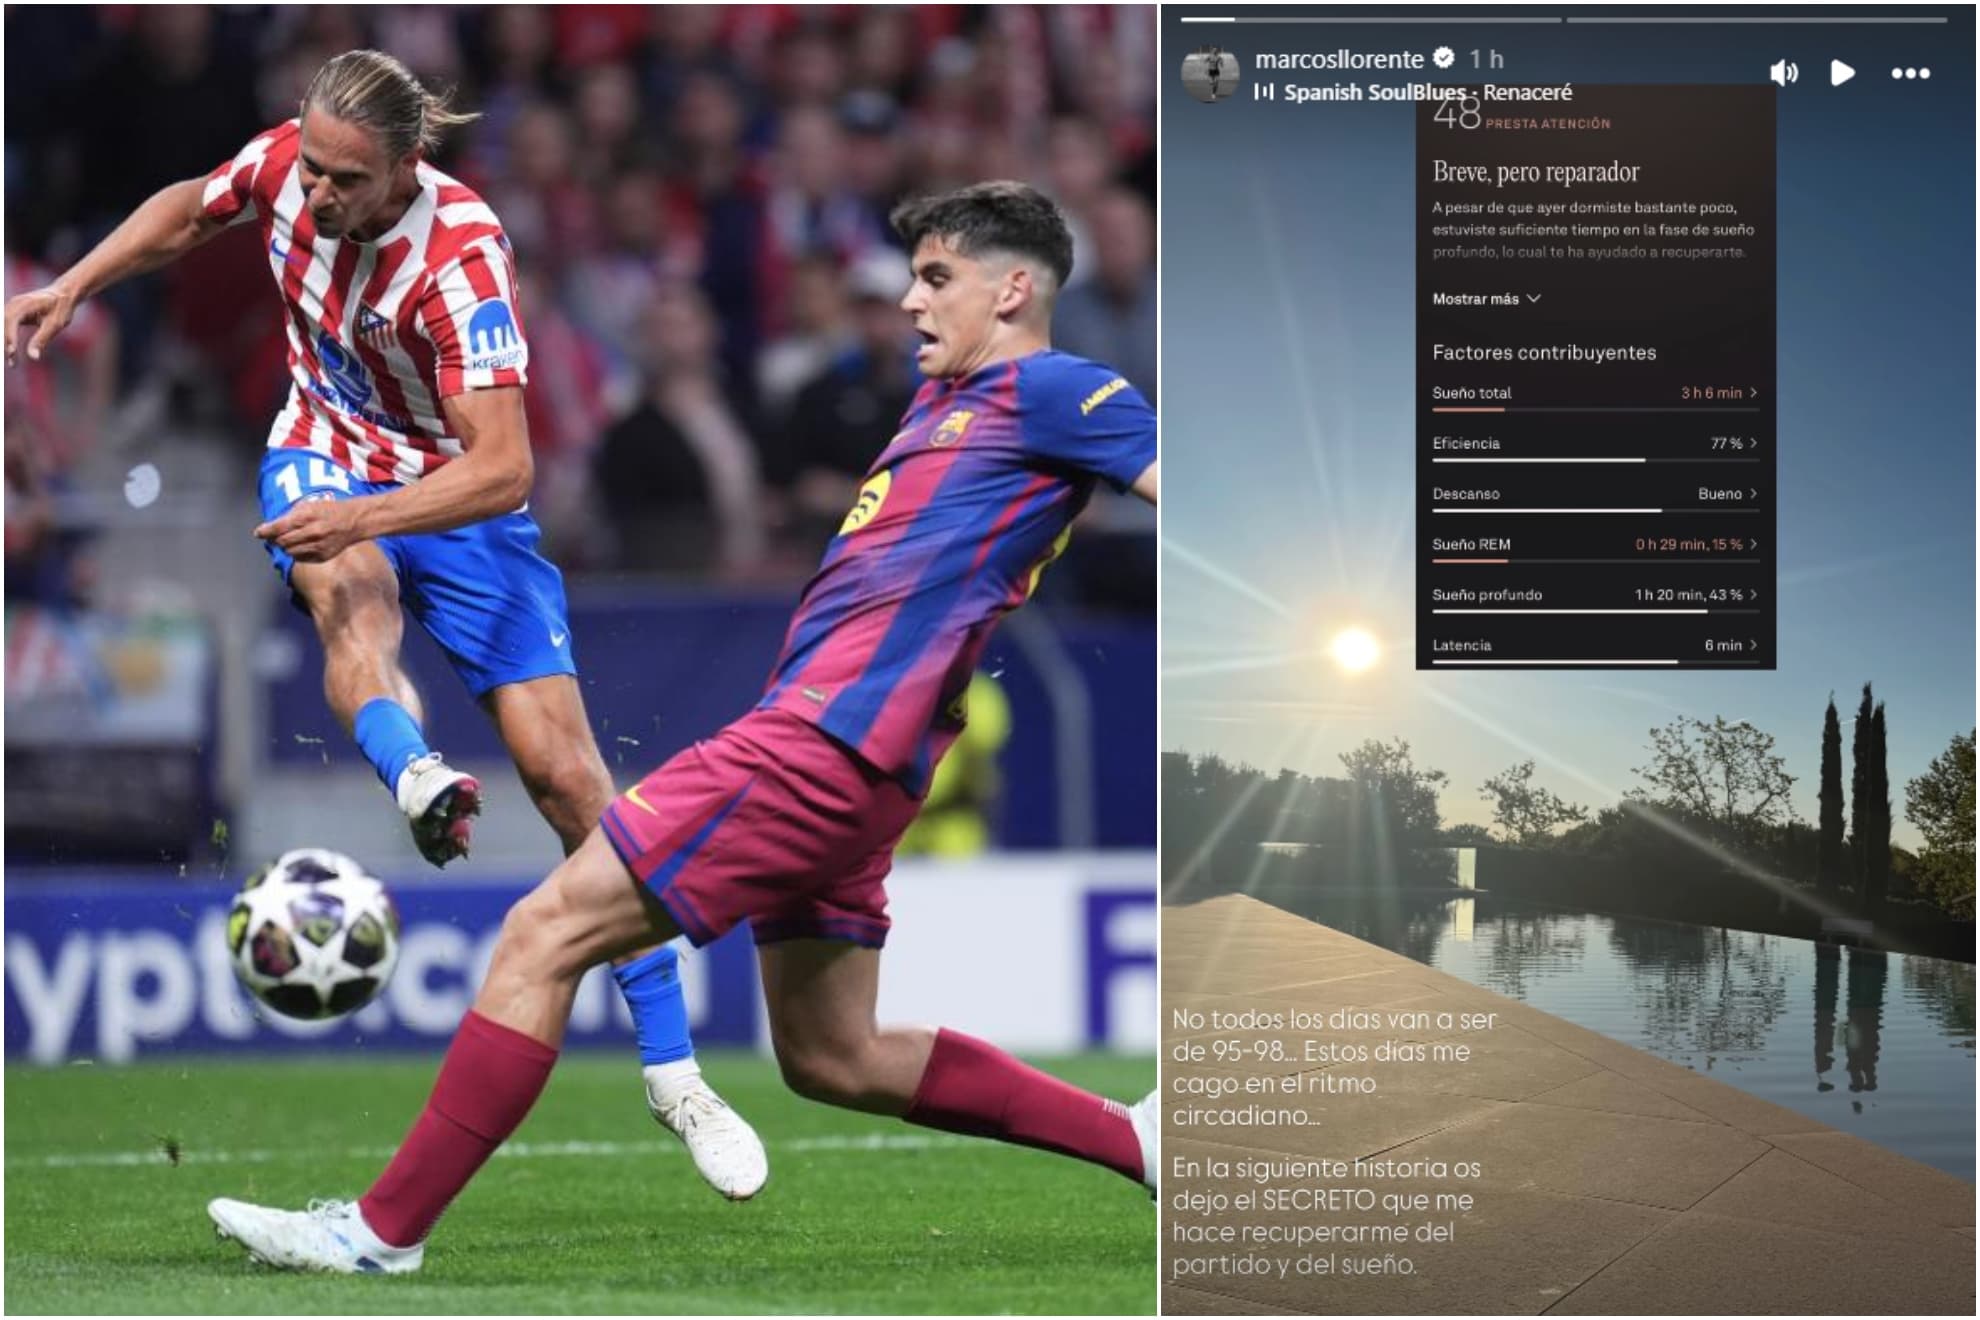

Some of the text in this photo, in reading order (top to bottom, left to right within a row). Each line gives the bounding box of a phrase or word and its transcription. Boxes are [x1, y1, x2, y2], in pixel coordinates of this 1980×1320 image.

[1432, 95, 1482, 130] 48
[1486, 117, 1610, 129] PRESTA ATENCIÓN
[1433, 159, 1641, 188] Breve, pero reparador
[1432, 201, 1736, 216] A pesar de que ayer dormiste bastante poco,
[1433, 223, 1754, 239] estuviste suficiente tiempo en la fase de sueño
[1433, 244, 1744, 260] profundo, lo cual te ha ayudado a recuperarte.
[1434, 293, 1519, 305] Mostrar más
[1433, 343, 1657, 365] Factores contribuyentes
[1432, 385, 1512, 400] Sueño total
[1682, 386, 1742, 399] 3 h 6 min
[1434, 437, 1500, 449] Eficiencia
[1434, 488, 1500, 500] Descanso
[1699, 488, 1742, 500] Bueno
[1433, 539, 1510, 550] Sueño REM
[1636, 539, 1645, 550] 0
[1649, 539, 1656, 550] h
[1660, 539, 1676, 550] 29
[1433, 588, 1543, 604] Sueño profundo
[1657, 589, 1673, 600] 20
[1677, 588, 1708, 603] min,
[1434, 640, 1492, 651] Latencia
[1706, 640, 1742, 651] 6 min
